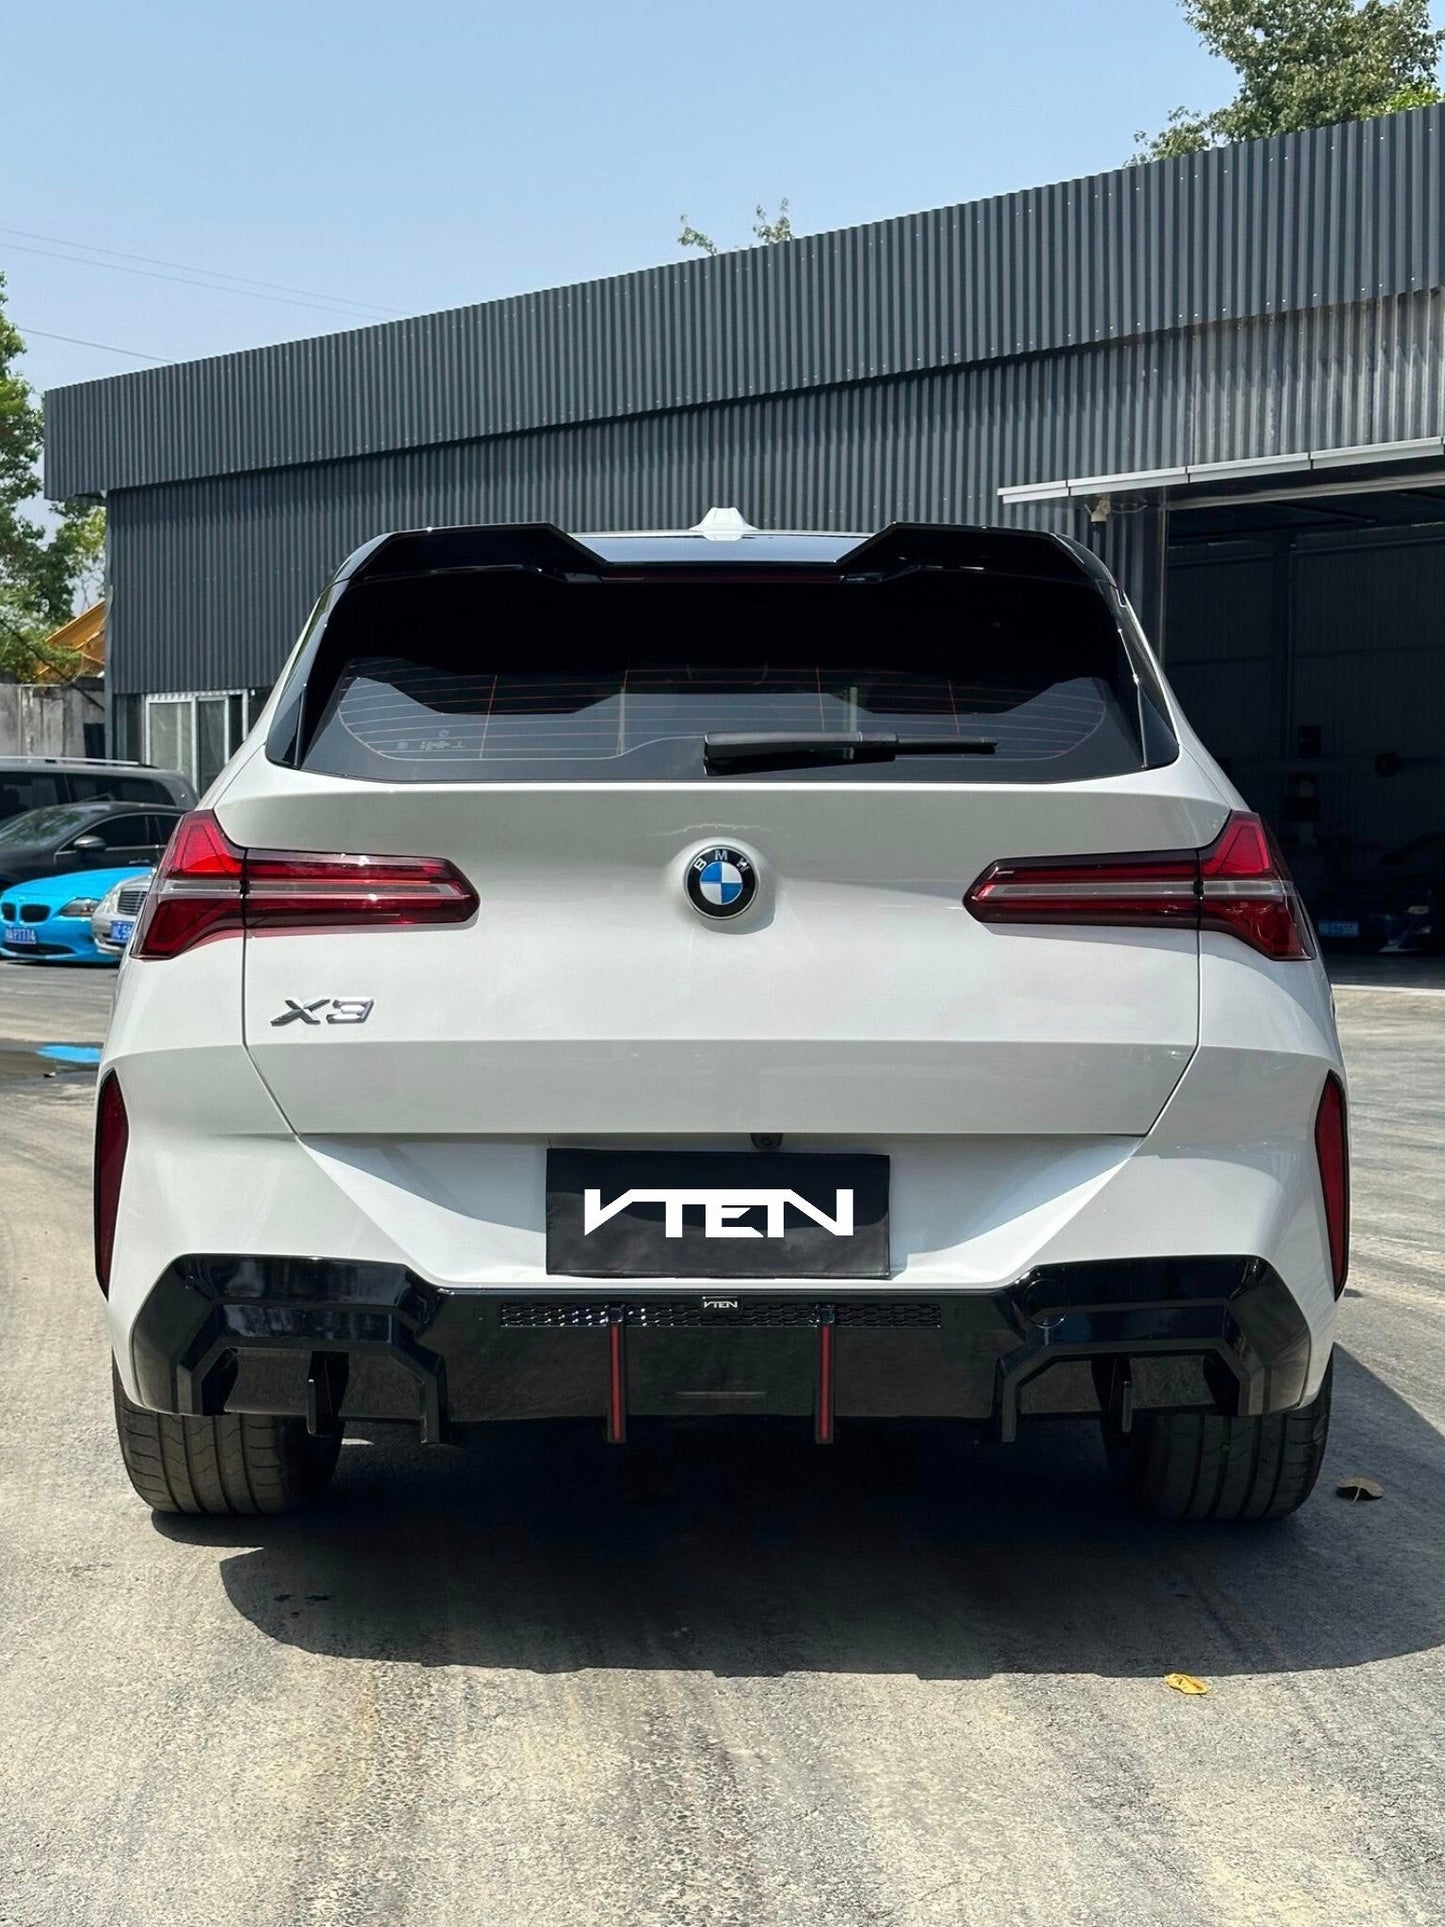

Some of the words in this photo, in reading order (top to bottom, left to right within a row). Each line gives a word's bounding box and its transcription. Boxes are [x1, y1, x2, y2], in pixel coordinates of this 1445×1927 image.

[693, 850, 750, 872] BMW
[270, 997, 374, 1026] X3
[584, 1188, 854, 1238] VTEN
[704, 1301, 738, 1309] VTEN
